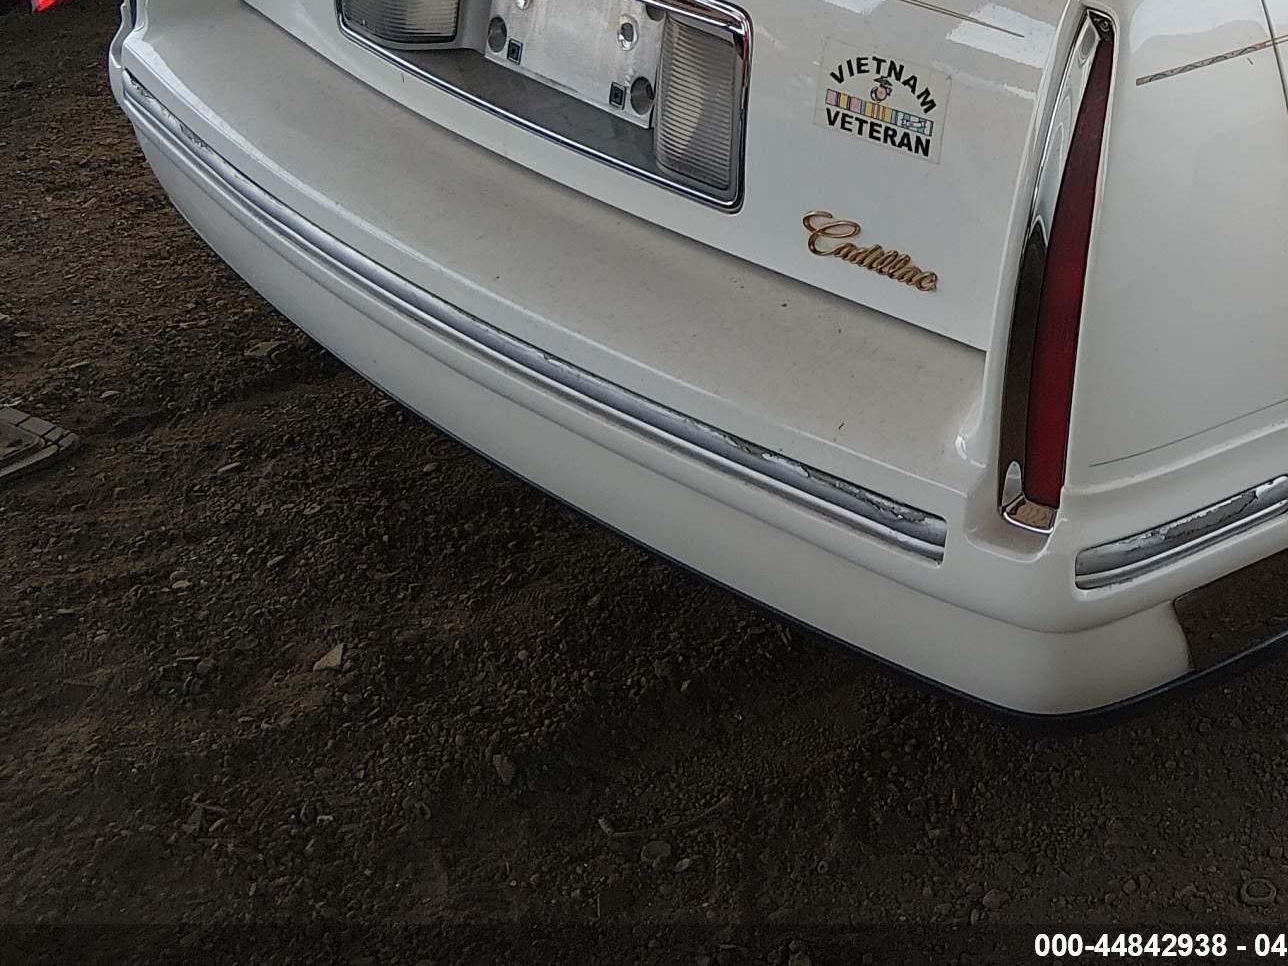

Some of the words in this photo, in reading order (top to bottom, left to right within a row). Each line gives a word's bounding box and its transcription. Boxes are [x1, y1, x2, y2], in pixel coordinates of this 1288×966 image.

[829, 56, 938, 114] VIETNAM
[825, 107, 931, 158] VETERAN
[802, 210, 939, 293] Cadillac
